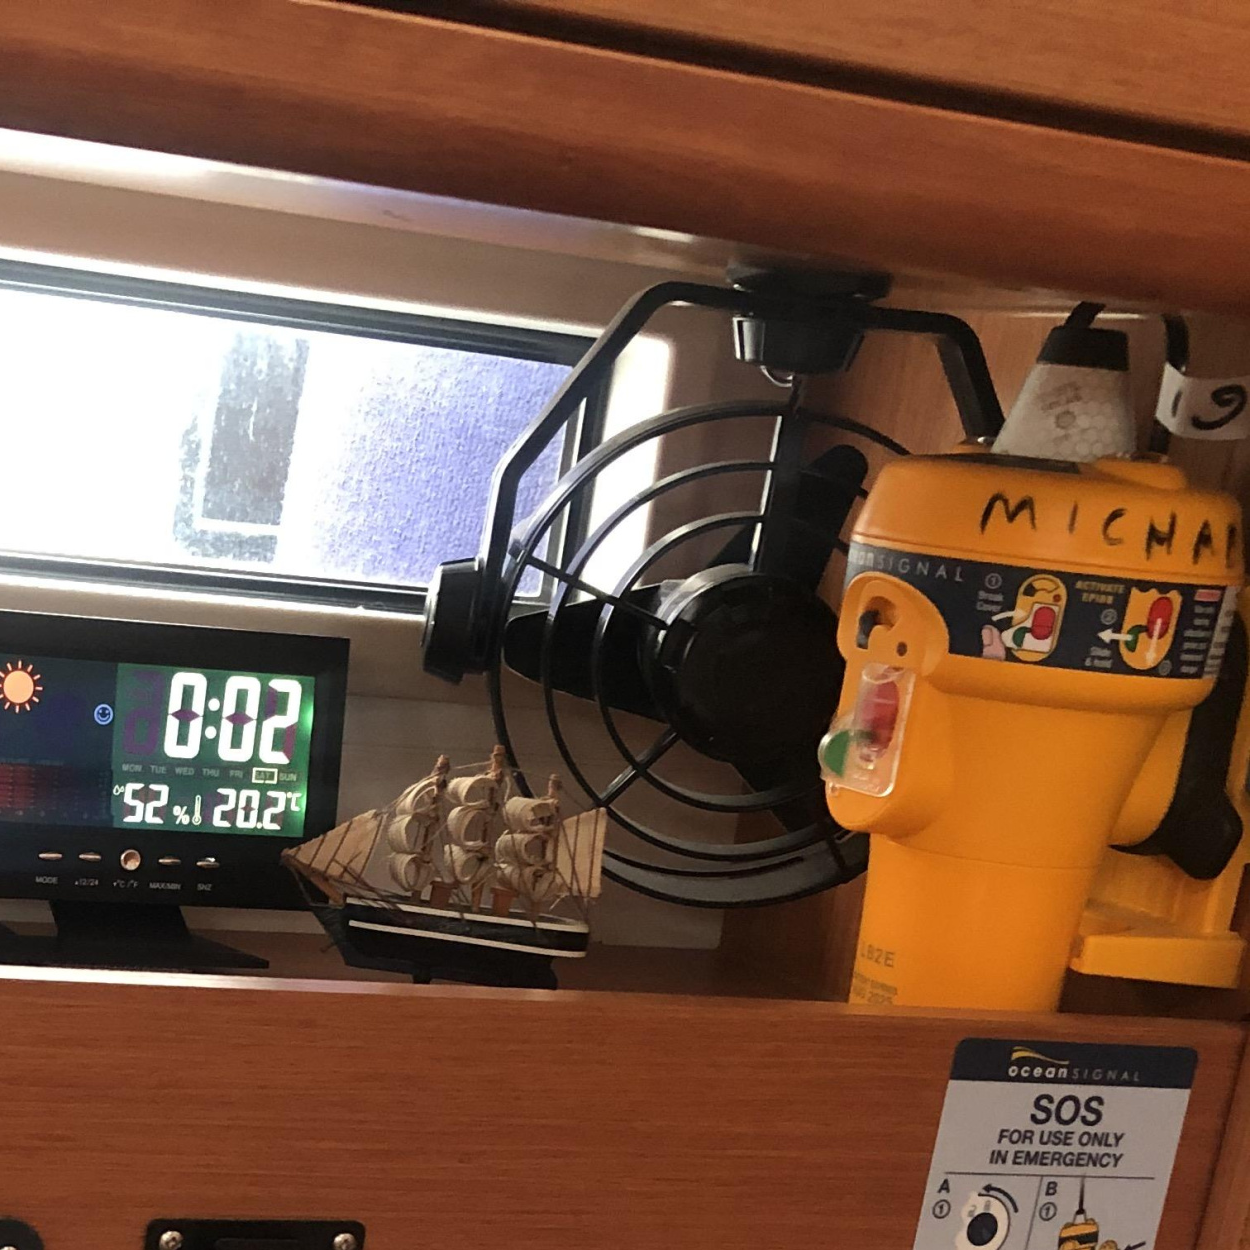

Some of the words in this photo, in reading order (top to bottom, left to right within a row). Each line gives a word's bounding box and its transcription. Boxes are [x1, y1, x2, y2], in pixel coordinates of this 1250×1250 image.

[163, 671, 303, 764] 0:02
[150, 764, 166, 774] TUE
[175, 766, 194, 776] WED
[202, 767, 220, 777] THU
[229, 769, 244, 779] FRI
[254, 771, 271, 780] SAT
[280, 773, 297, 782] SUN
[35, 876, 59, 885] MODE
[1008, 1063, 1068, 1079] ocean
[1072, 1069, 1141, 1083] SIGNAL
[1029, 1093, 1105, 1127] SOS
[997, 1128, 1037, 1145] FOR
[1039, 1130, 1076, 1147] USE
[1078, 1132, 1125, 1148] ONLY
[989, 1149, 1009, 1165] IN
[1012, 1151, 1124, 1169] EMERGENCY
[937, 1179, 950, 1194] A
[1045, 1181, 1058, 1196] B
